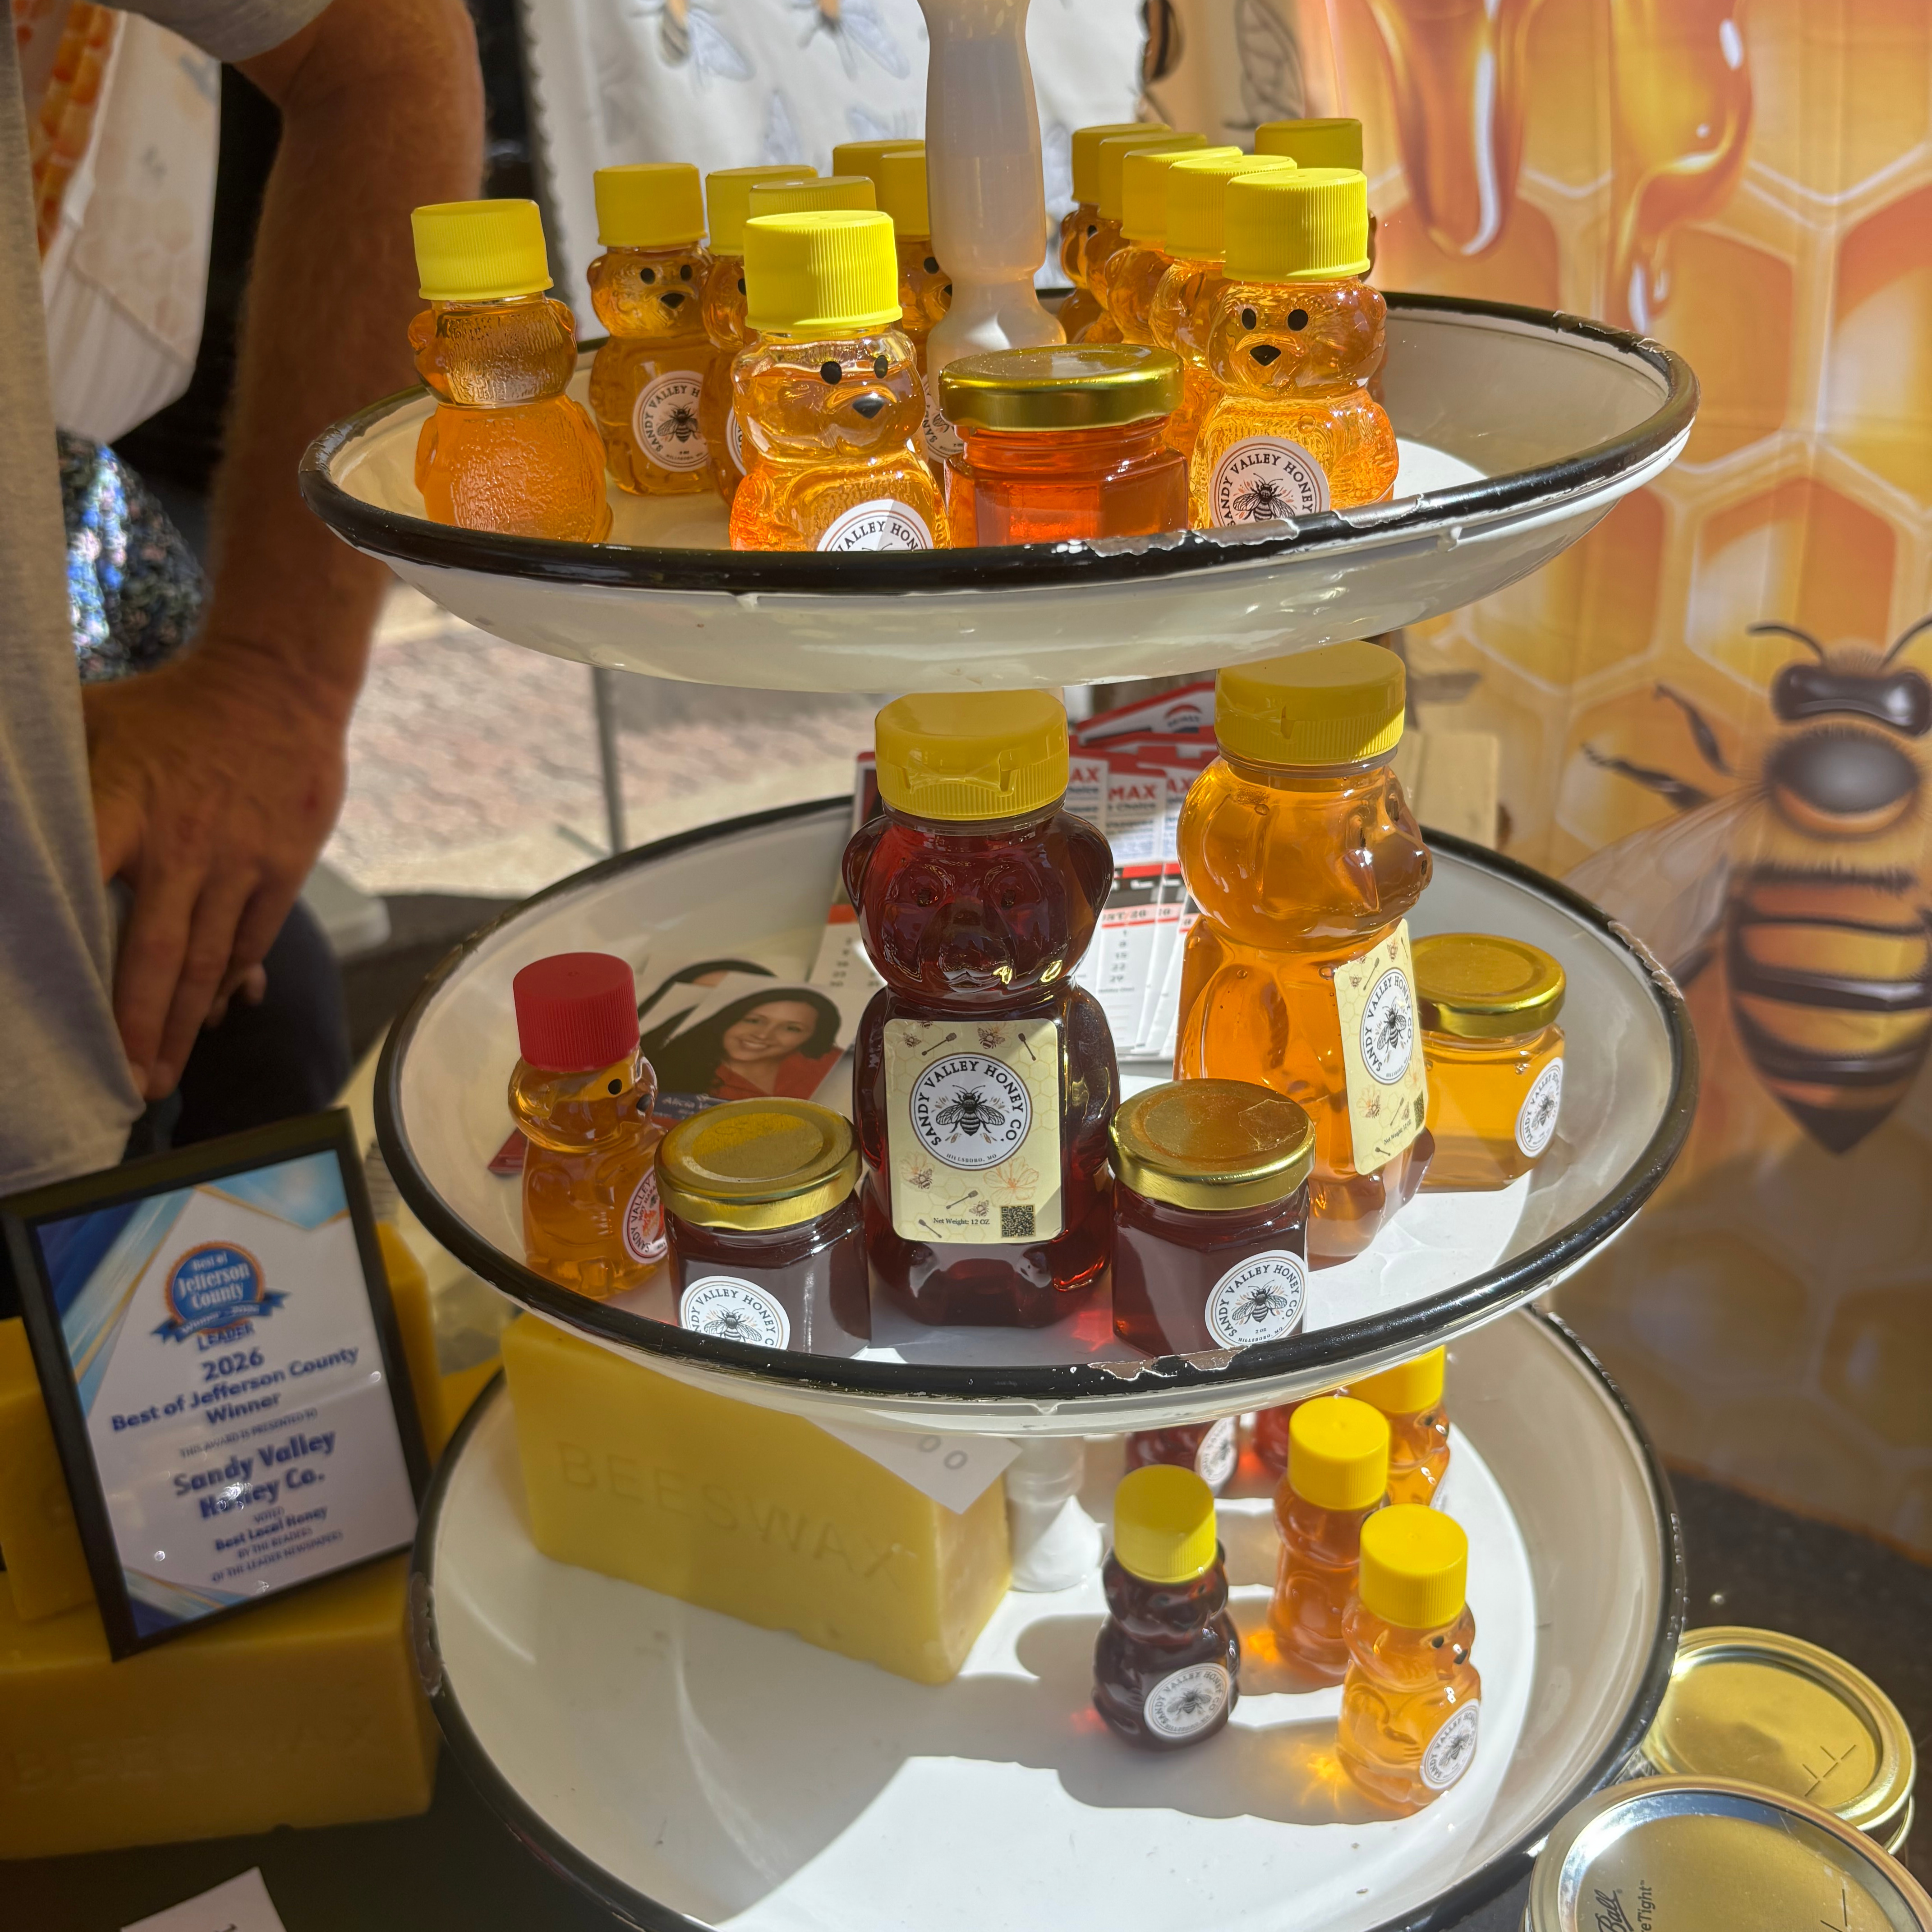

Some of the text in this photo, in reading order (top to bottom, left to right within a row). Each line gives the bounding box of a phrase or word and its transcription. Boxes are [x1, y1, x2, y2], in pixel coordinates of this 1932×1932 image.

[645, 385, 687, 452] SANDY VALLEY
[1230, 453, 1281, 474] VALLEY
[1283, 461, 1313, 515] HONEY
[890, 523, 919, 551] HON
[1367, 976, 1392, 1019] VALLEY
[1394, 975, 1411, 1010] HONEY
[1366, 1026, 1382, 1072] SANDY
[918, 1060, 1023, 1145] SANDY VALLEY HONEY CO.
[630, 1179, 651, 1253] SANDY VALLEY
[945, 1218, 969, 1226] Weight:
[191, 1282, 244, 1309] County
[1225, 1264, 1270, 1293] VALLEY
[1273, 1265, 1299, 1294] HONEY
[695, 1289, 739, 1306] VALLEY
[742, 1294, 776, 1334] HONEY
[691, 1306, 702, 1333] NDY
[1219, 1299, 1237, 1337] SANDY
[201, 1347, 266, 1381] 2026
[111, 1346, 359, 1433] Best of Jefferson County
[206, 1392, 282, 1426] Winner
[173, 1431, 336, 1496] Sandy Valley
[285, 1467, 326, 1490] Co.
[557, 1442, 905, 1590] BEESWAX
[1164, 1671, 1201, 1693] VALLEY
